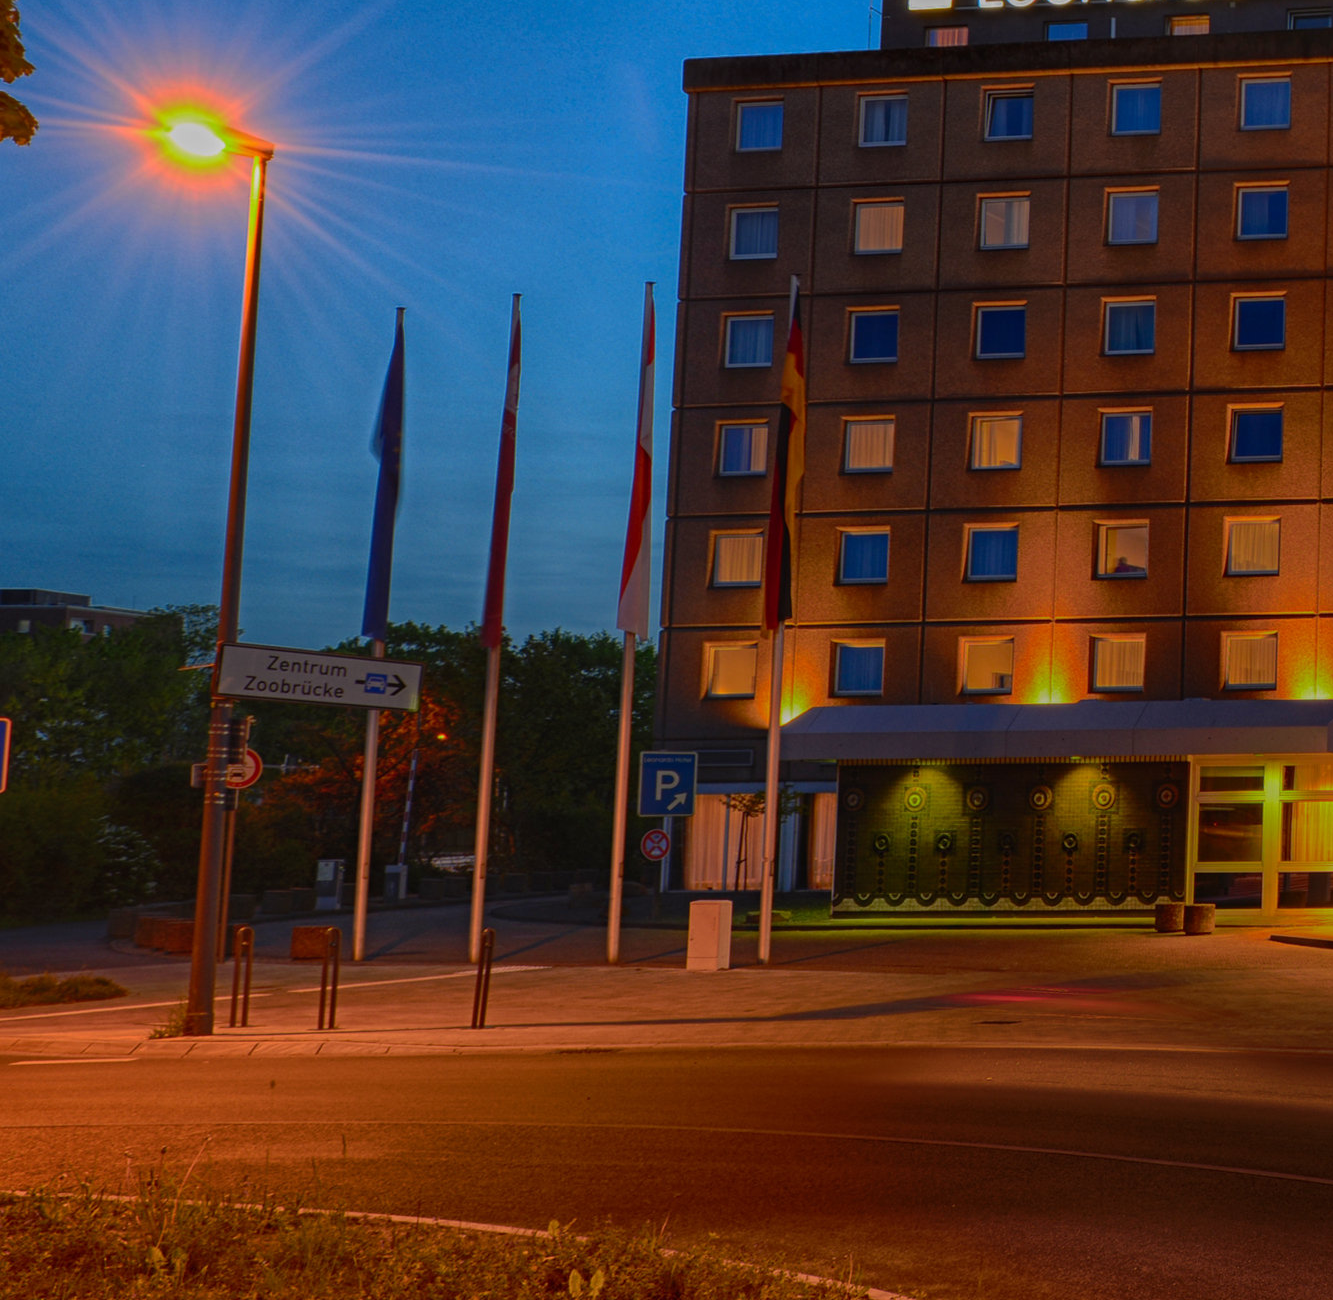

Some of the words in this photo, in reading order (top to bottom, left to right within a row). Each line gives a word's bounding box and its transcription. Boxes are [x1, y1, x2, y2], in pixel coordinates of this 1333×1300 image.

[267, 655, 347, 677] Zentrum
[243, 675, 345, 698] Zoobrücke
[655, 770, 680, 801] P
